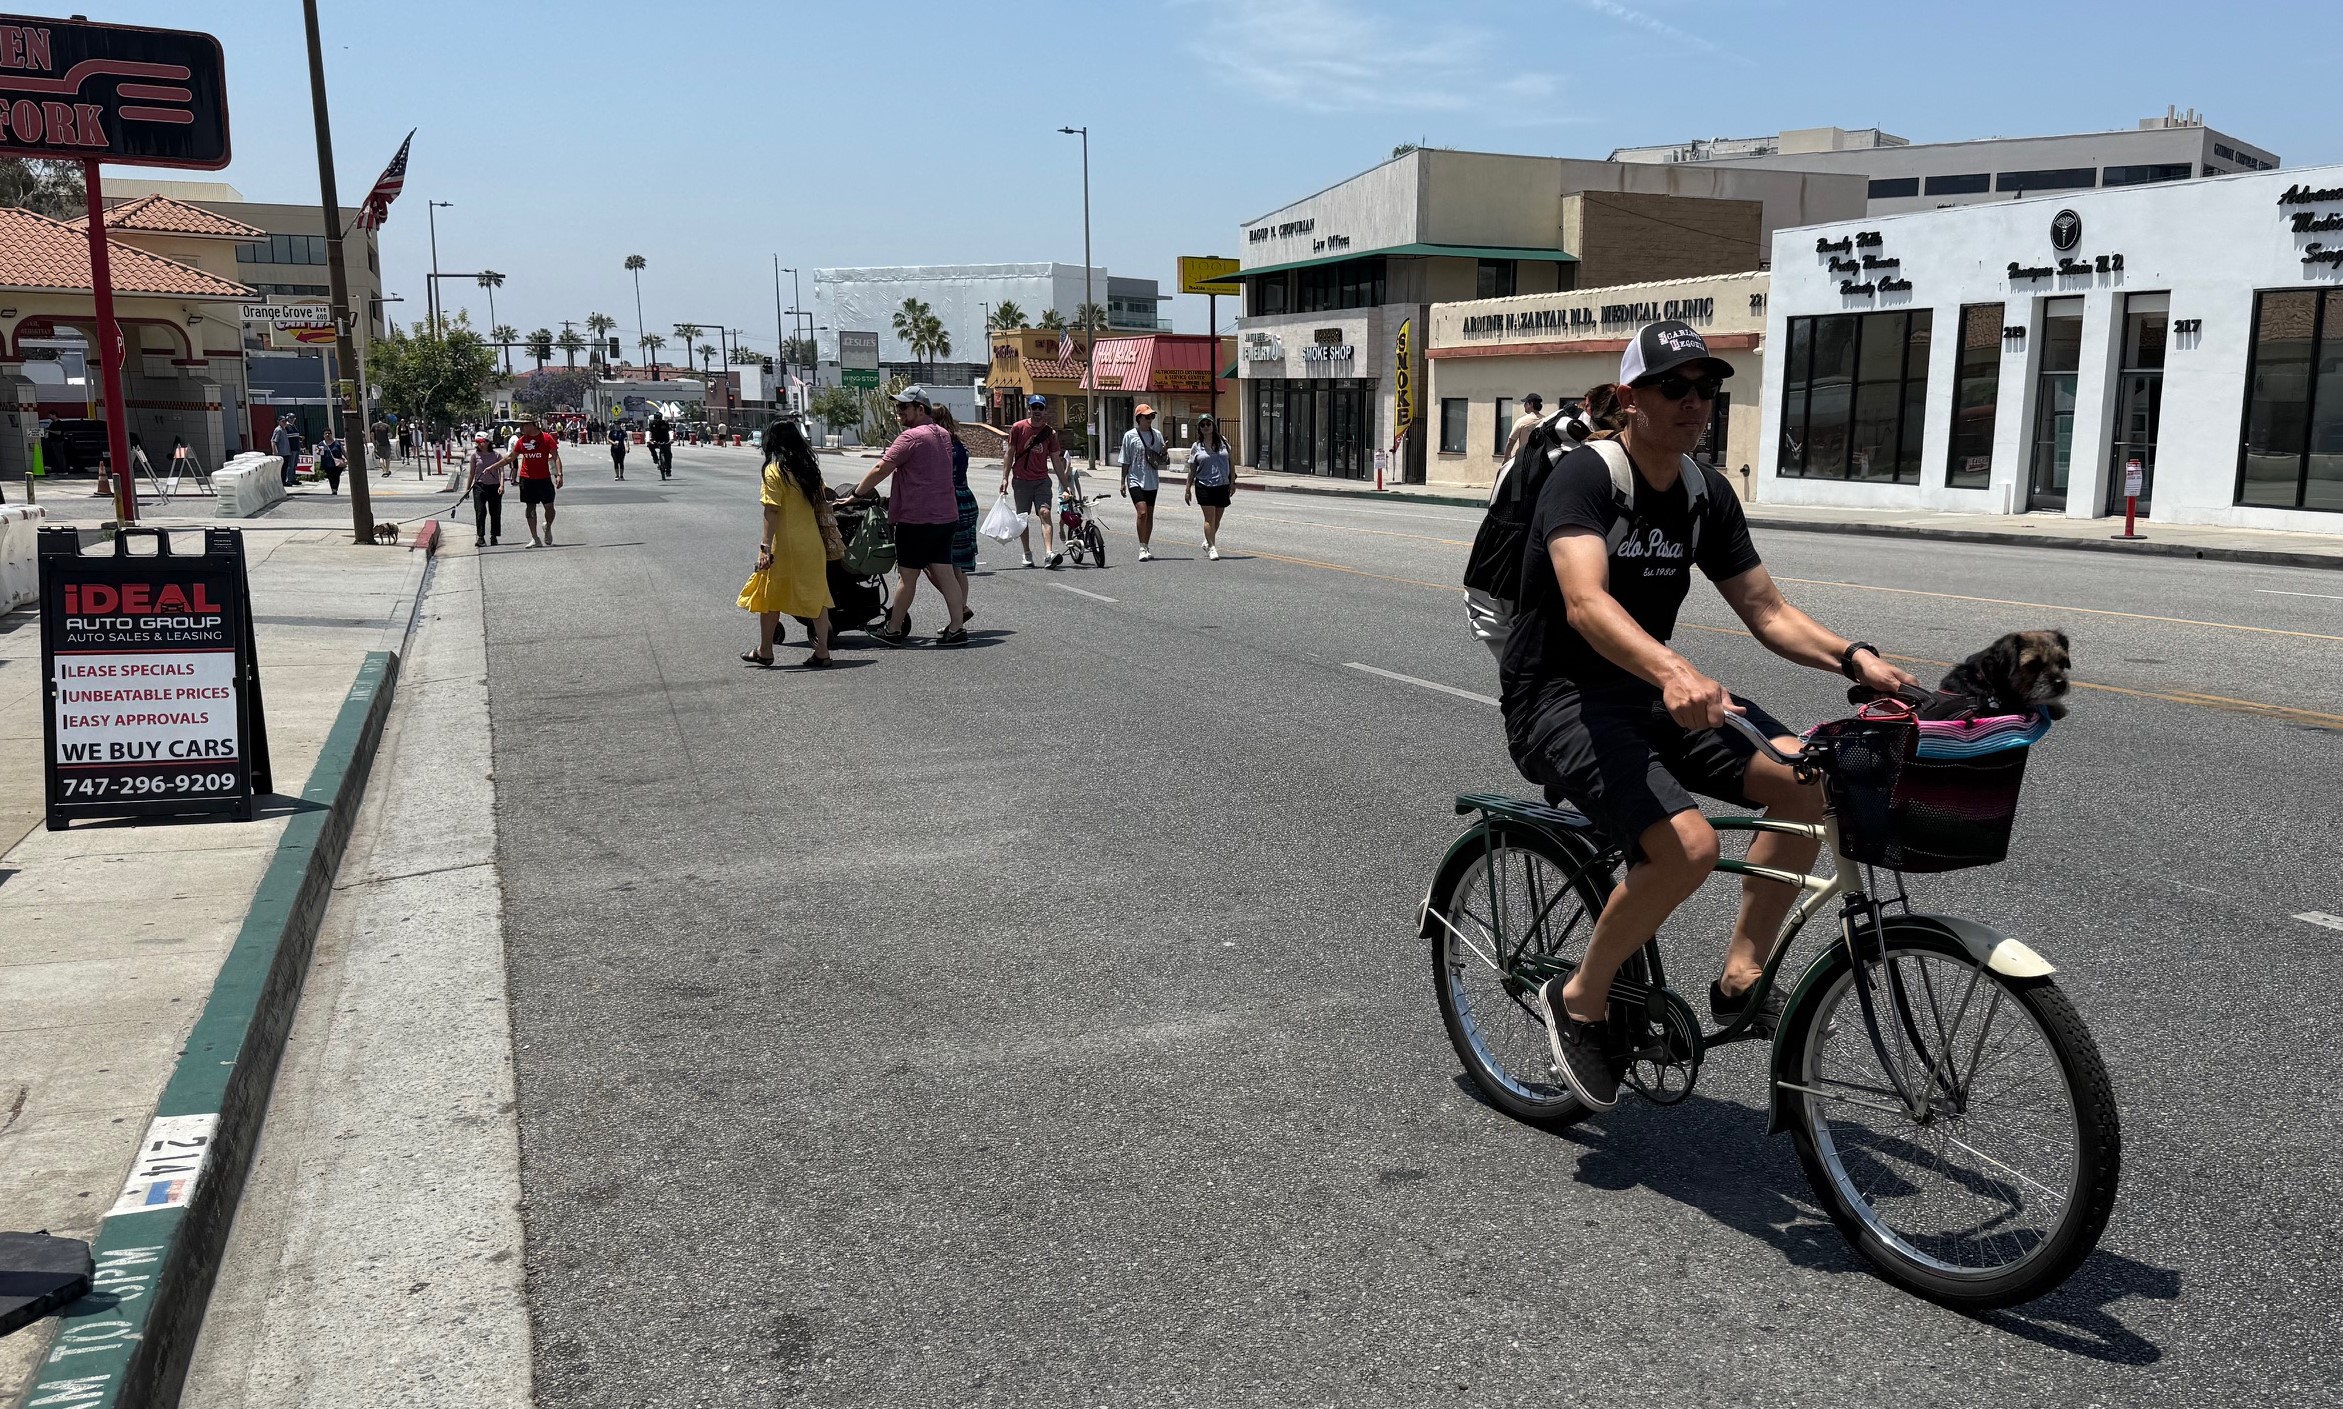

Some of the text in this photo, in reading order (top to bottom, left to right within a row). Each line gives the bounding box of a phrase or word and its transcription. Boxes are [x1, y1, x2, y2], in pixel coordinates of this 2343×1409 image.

[1313, 234, 1350, 251] Law Offices
[243, 305, 281, 320] Orange
[282, 305, 313, 318] Grove
[1600, 301, 1661, 324] MEDICAL
[1663, 297, 1714, 320] CLINIC
[2173, 319, 2202, 333] 217
[1302, 345, 1353, 361] SMOKE SHOP
[298, 456, 313, 464] TER
[1617, 528, 1644, 558] elo
[66, 616, 221, 631] AUTO GROUP
[67, 631, 222, 642] AUTO SALES & LEASING
[67, 663, 195, 678] LEASE SPECIALS
[68, 687, 230, 703] UNBEATABLE PRICES
[69, 712, 209, 728] EASY APPROVALS
[61, 738, 234, 761] WE BUY CARS
[63, 772, 236, 797] 747-296-9209
[139, 1135, 208, 1177] 214
[49, 1320, 133, 1363] TO
